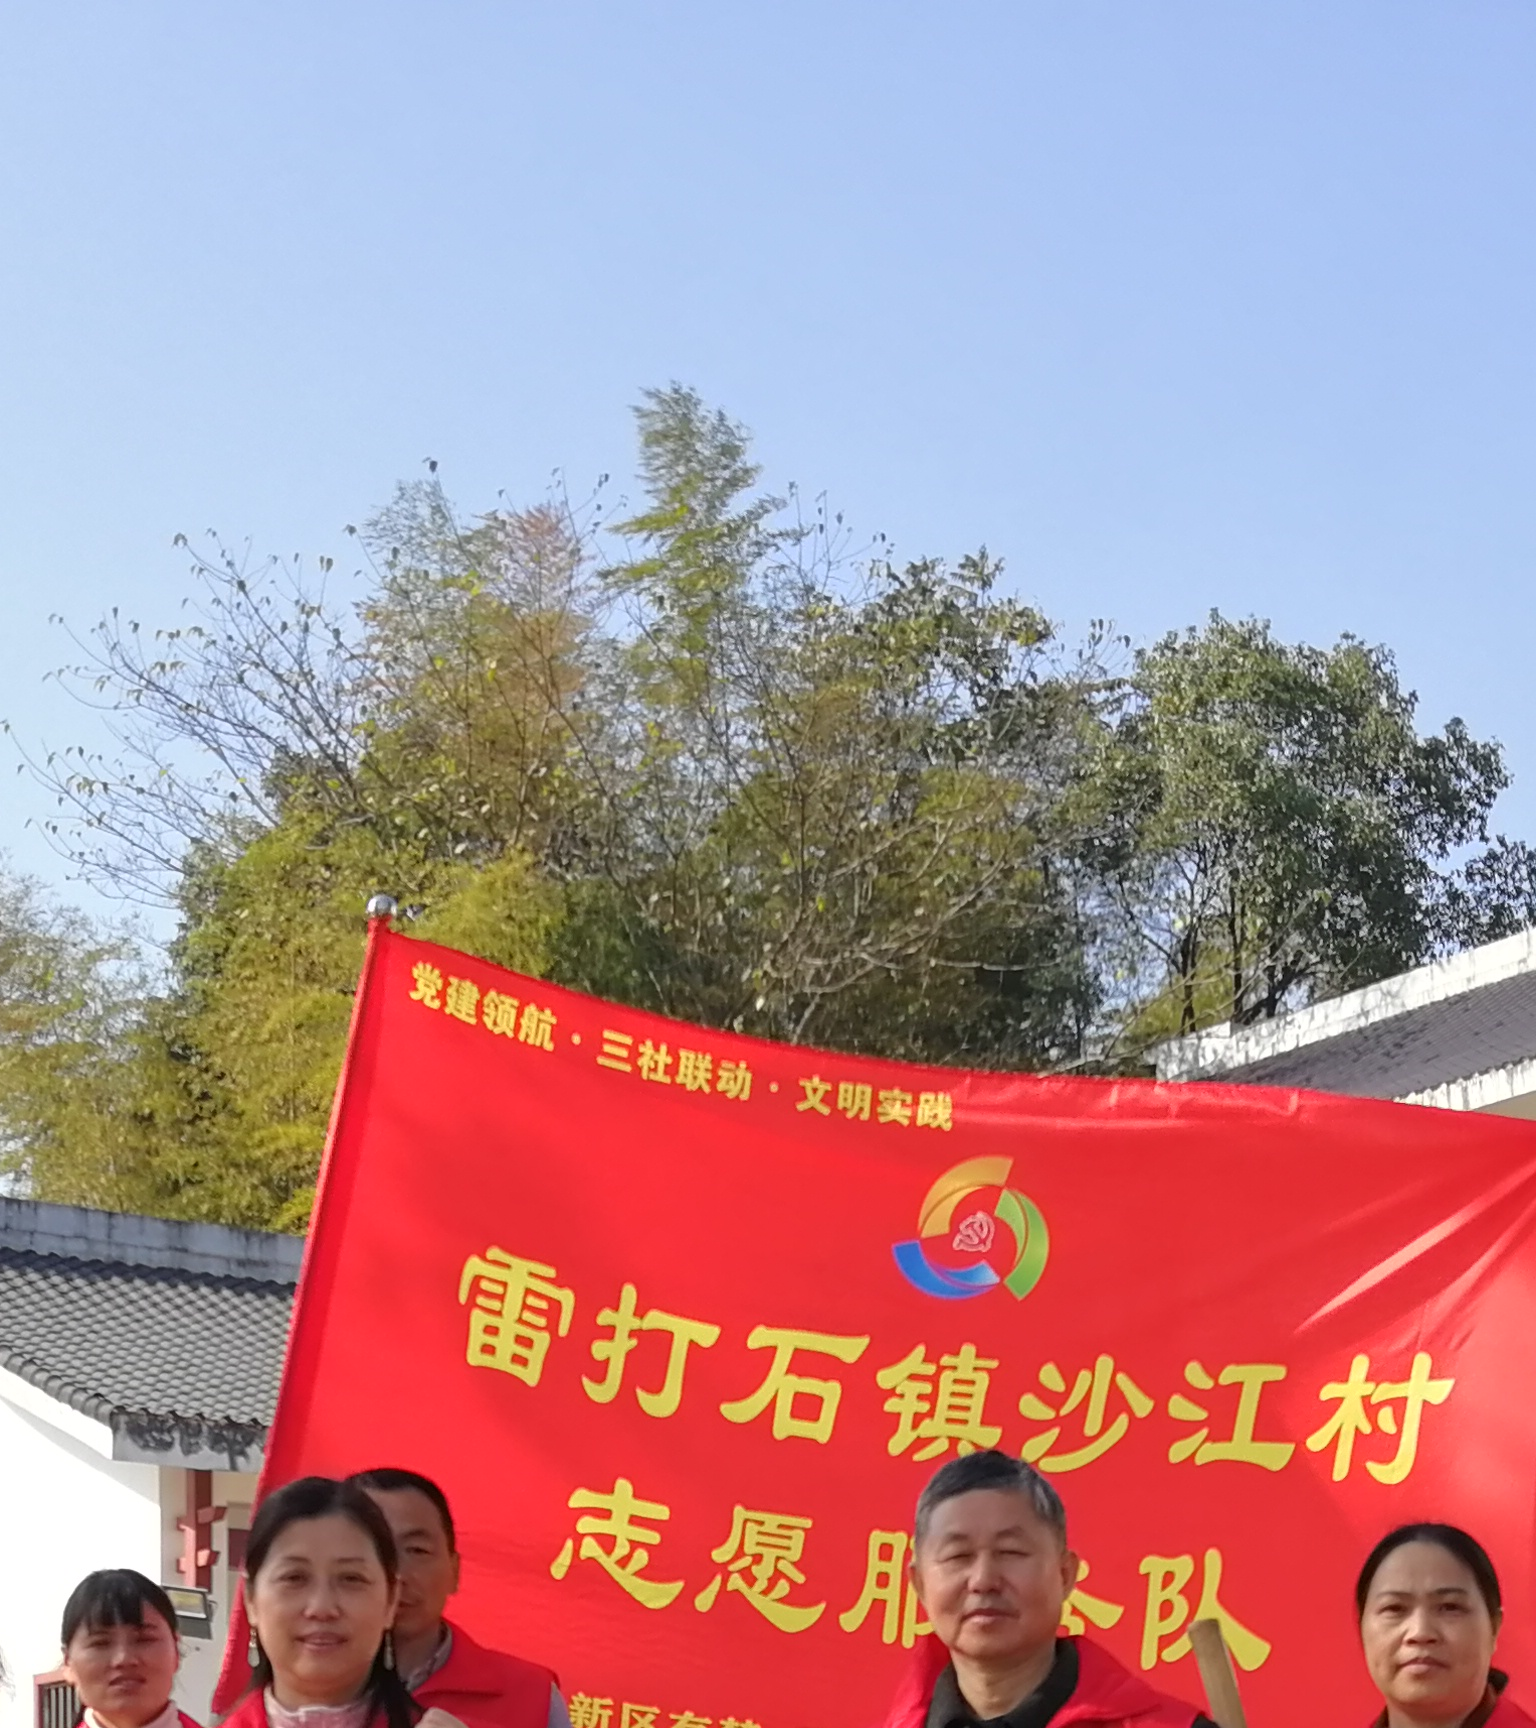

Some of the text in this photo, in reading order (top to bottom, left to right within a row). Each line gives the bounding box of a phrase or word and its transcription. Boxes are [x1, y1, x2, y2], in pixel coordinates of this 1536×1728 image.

[458, 1245, 1456, 1485] 雷打石镇沙江村
